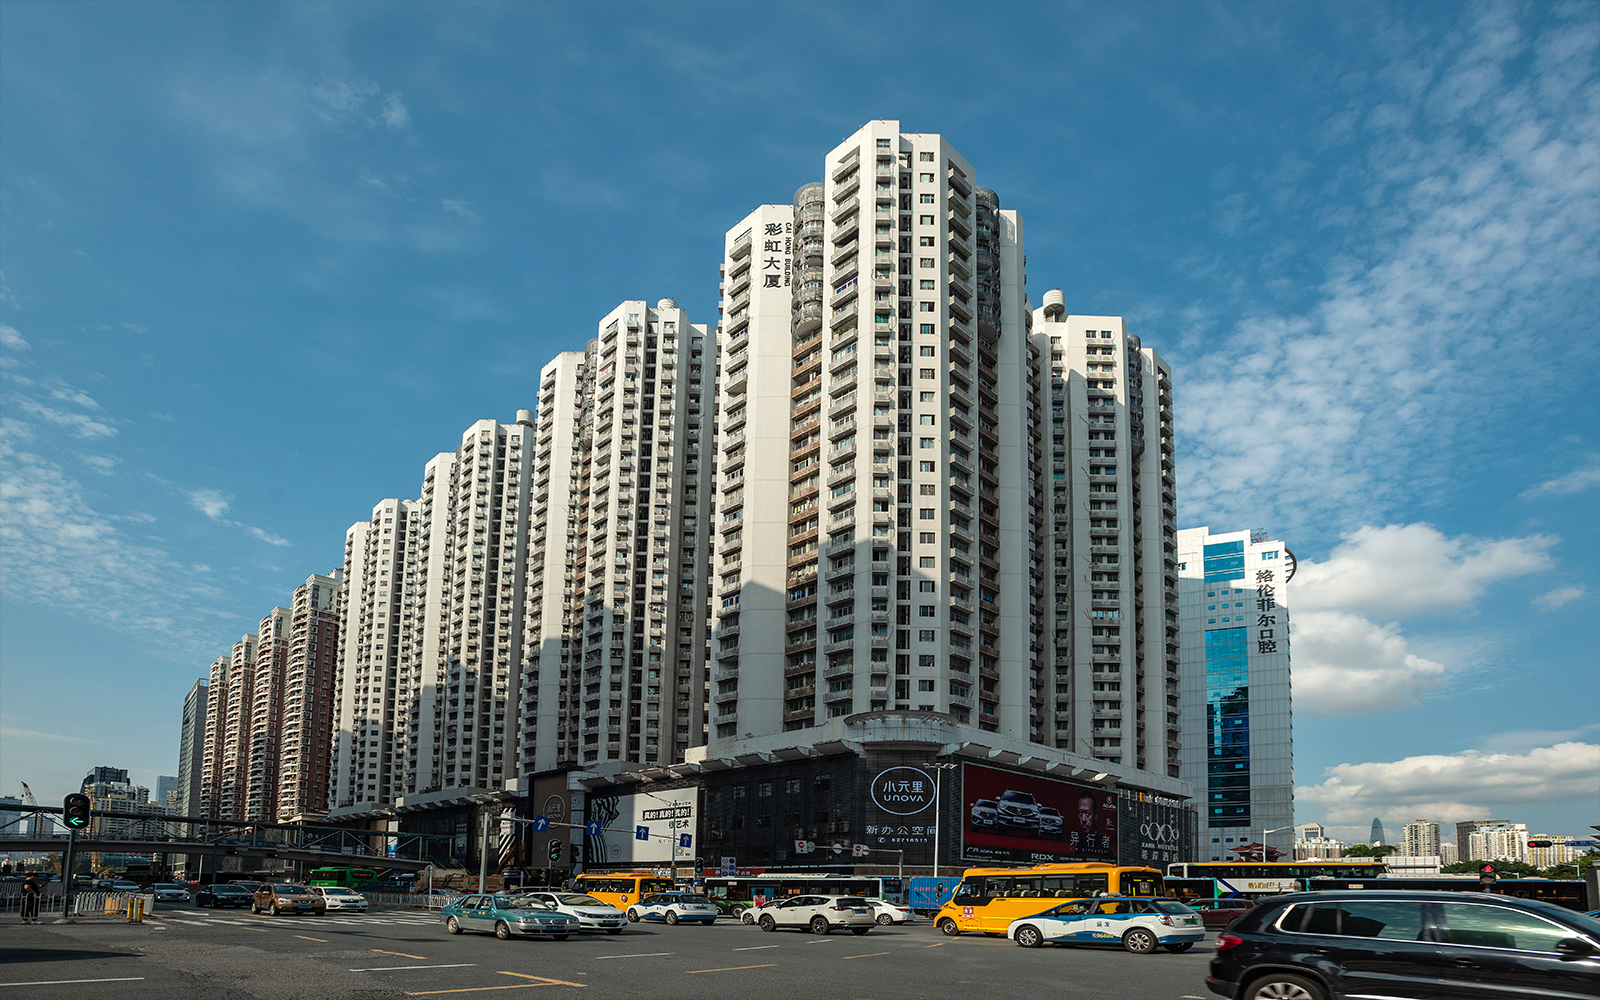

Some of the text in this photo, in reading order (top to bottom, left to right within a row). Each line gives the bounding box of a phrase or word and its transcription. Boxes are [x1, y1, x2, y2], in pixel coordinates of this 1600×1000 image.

[763, 222, 783, 288] 彩虹大厦
[1256, 570, 1277, 654] 格伦菲尔口腔
[883, 781, 924, 793] 小元里
[1069, 831, 1111, 849] 异行者
[1031, 852, 1054, 861] RDX
